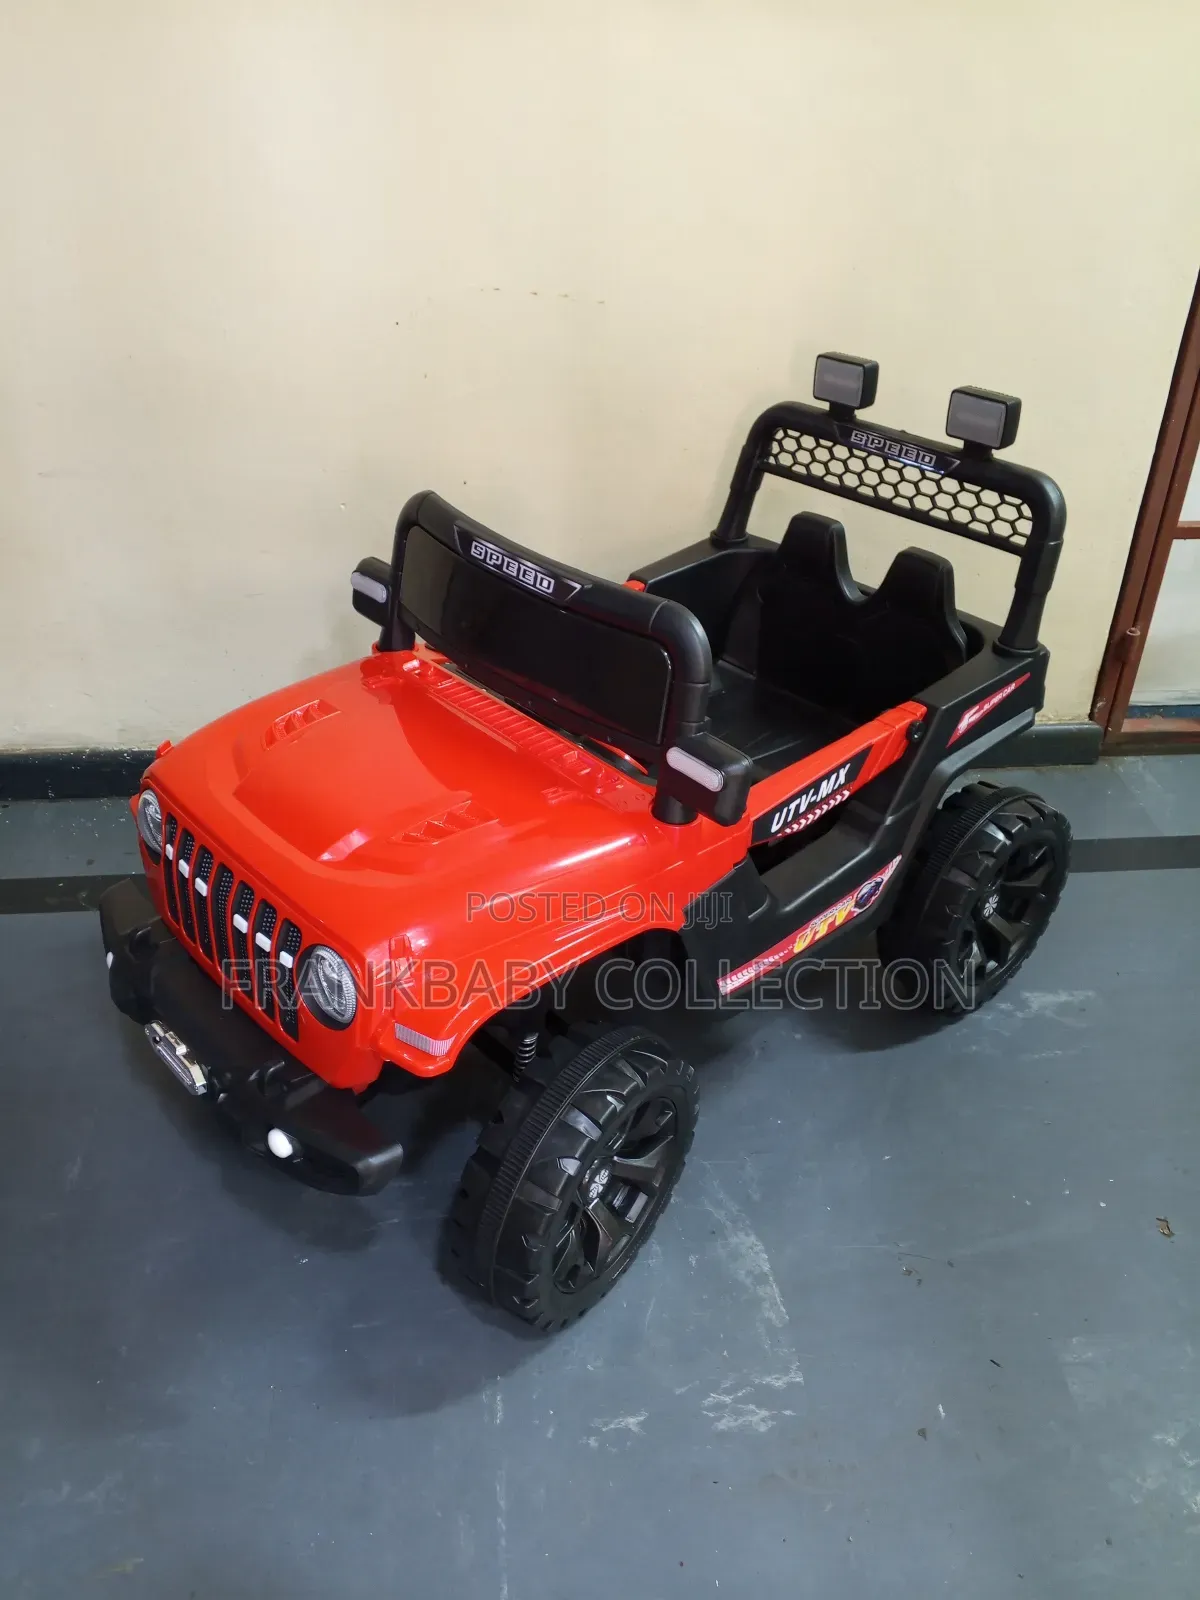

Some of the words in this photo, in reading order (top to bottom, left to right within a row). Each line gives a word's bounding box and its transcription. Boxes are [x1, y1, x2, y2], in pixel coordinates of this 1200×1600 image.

[851, 430, 937, 467] SPEED
[470, 541, 555, 594] SPEED
[770, 763, 851, 833] UTV-MX
